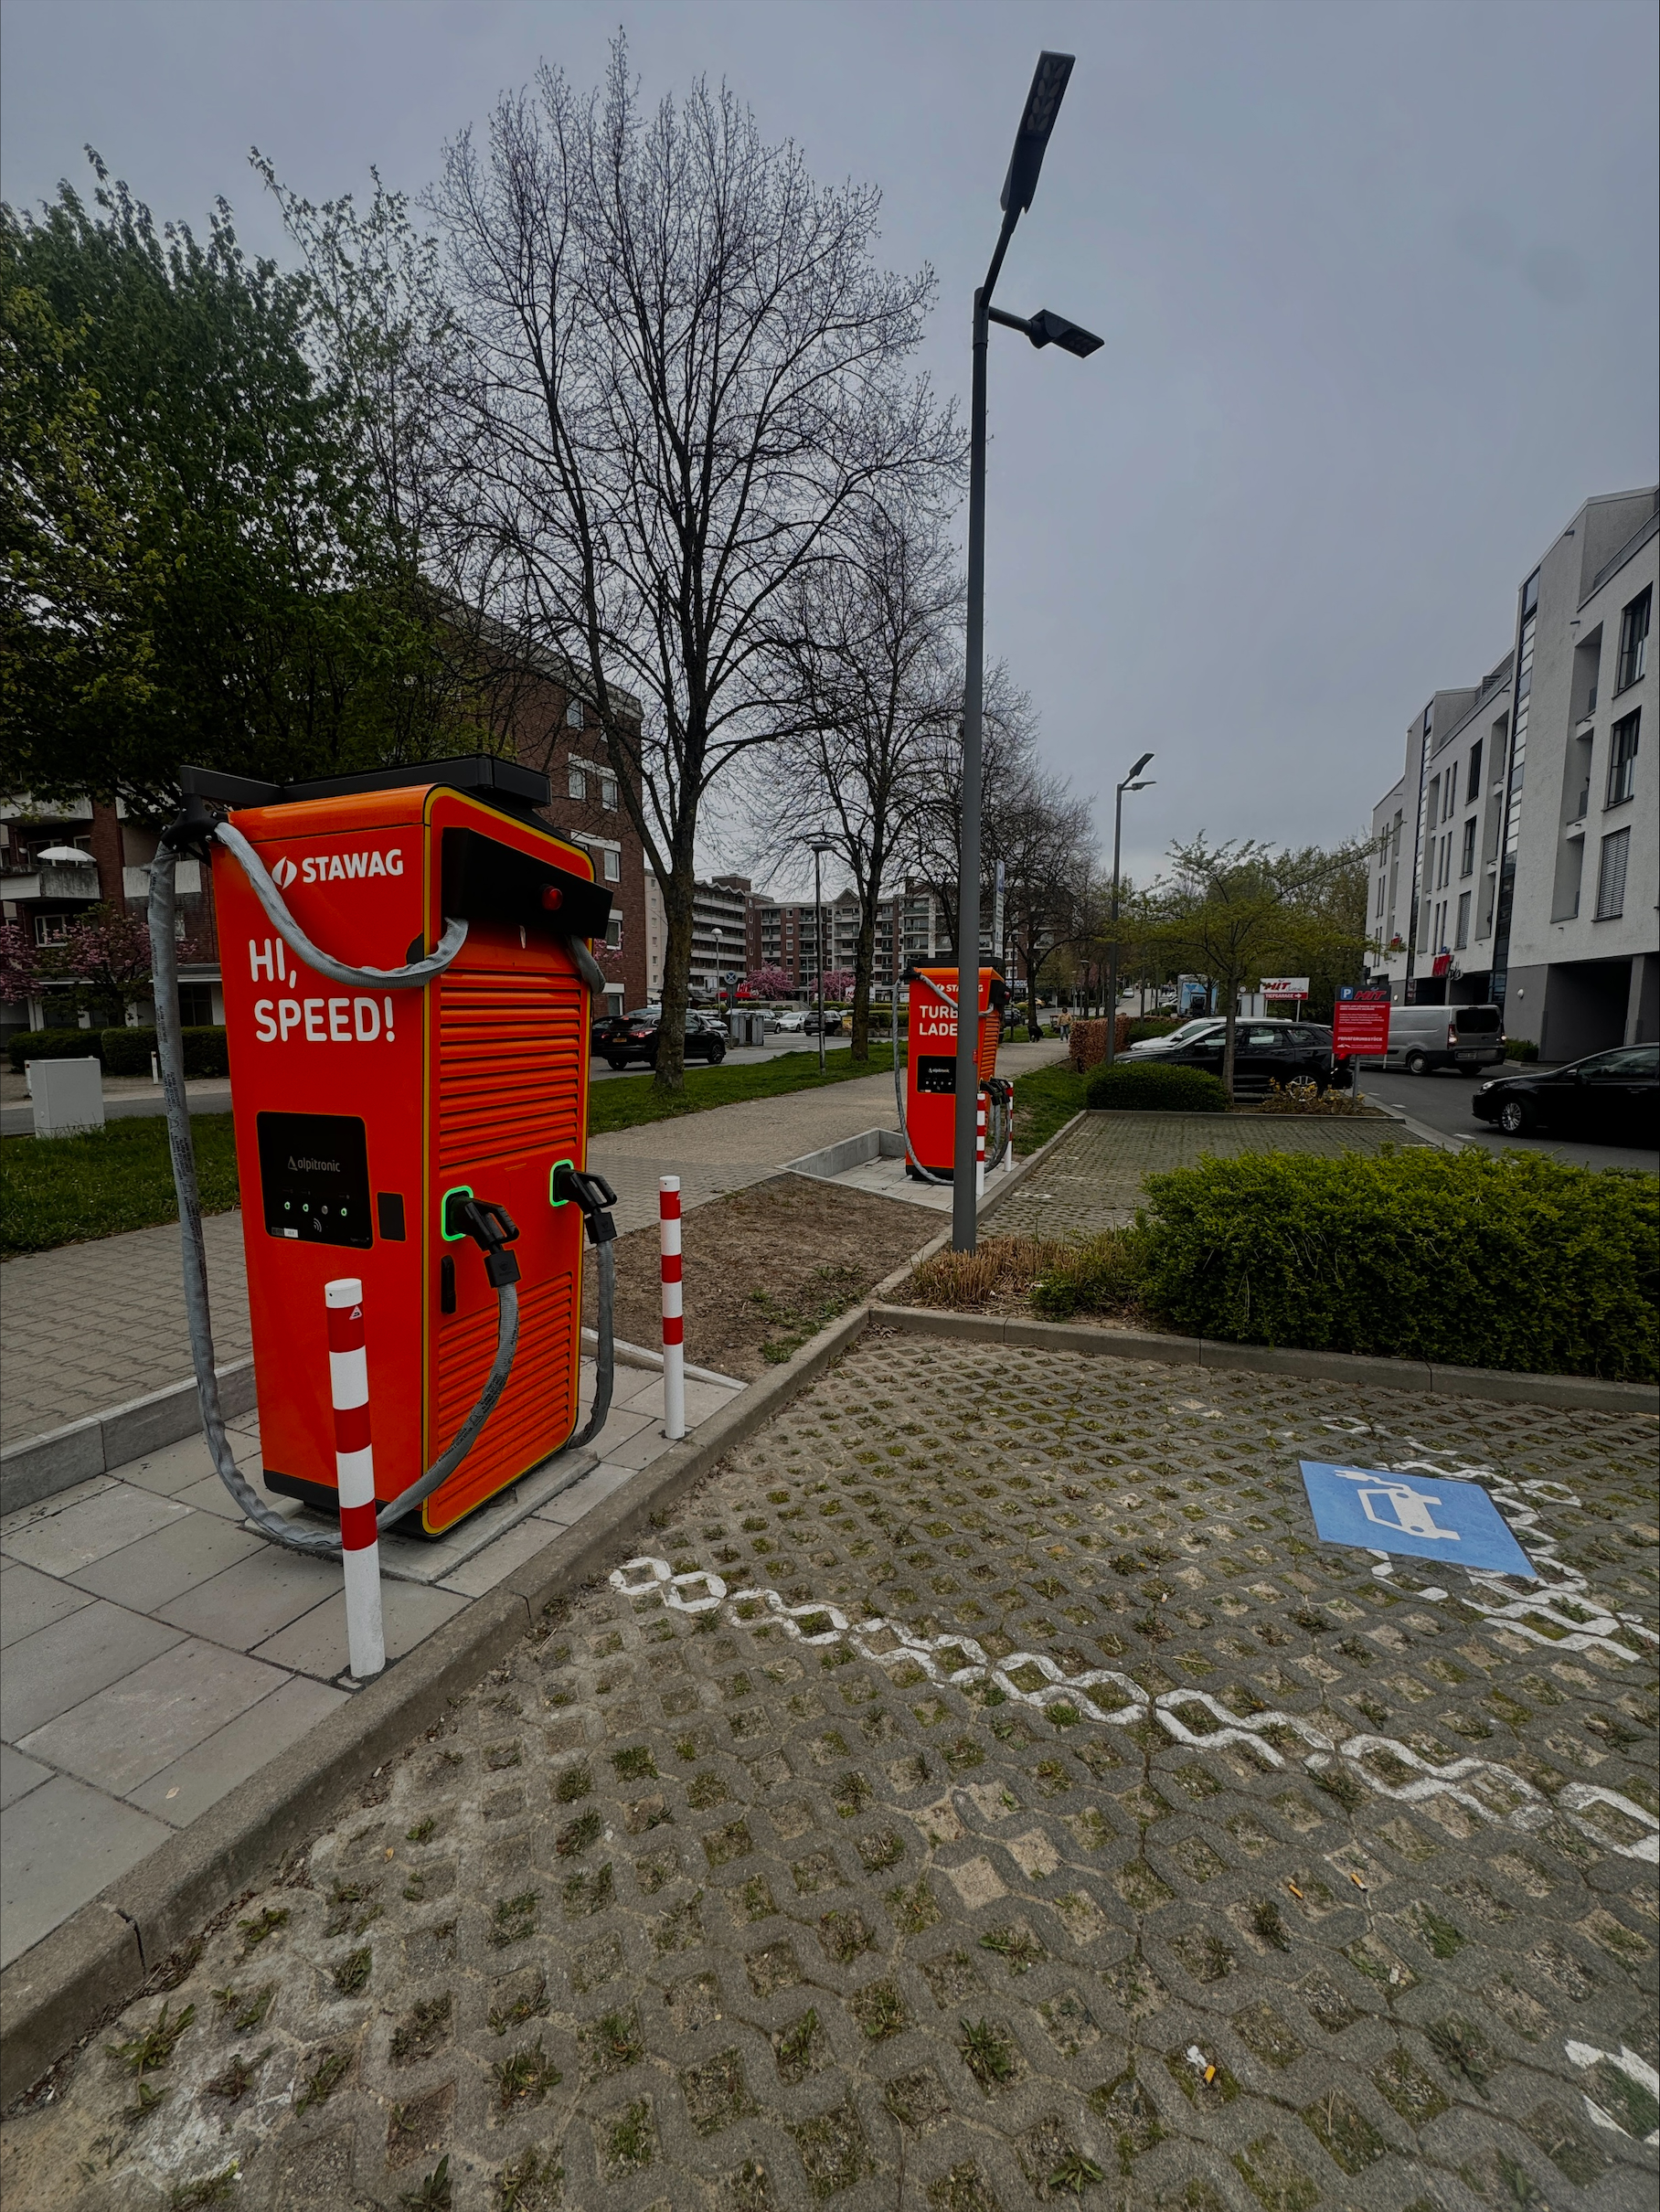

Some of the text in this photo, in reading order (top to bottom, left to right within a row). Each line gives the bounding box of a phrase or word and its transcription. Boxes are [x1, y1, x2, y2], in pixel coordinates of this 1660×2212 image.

[303, 848, 404, 884] STAWAG
[249, 937, 297, 989] HI,
[1343, 988, 1388, 1001] P HIT
[254, 995, 396, 1044] SPEED!
[919, 1005, 958, 1019] TURB
[919, 1022, 958, 1037] LADE
[297, 1157, 341, 1173] alpitronic
